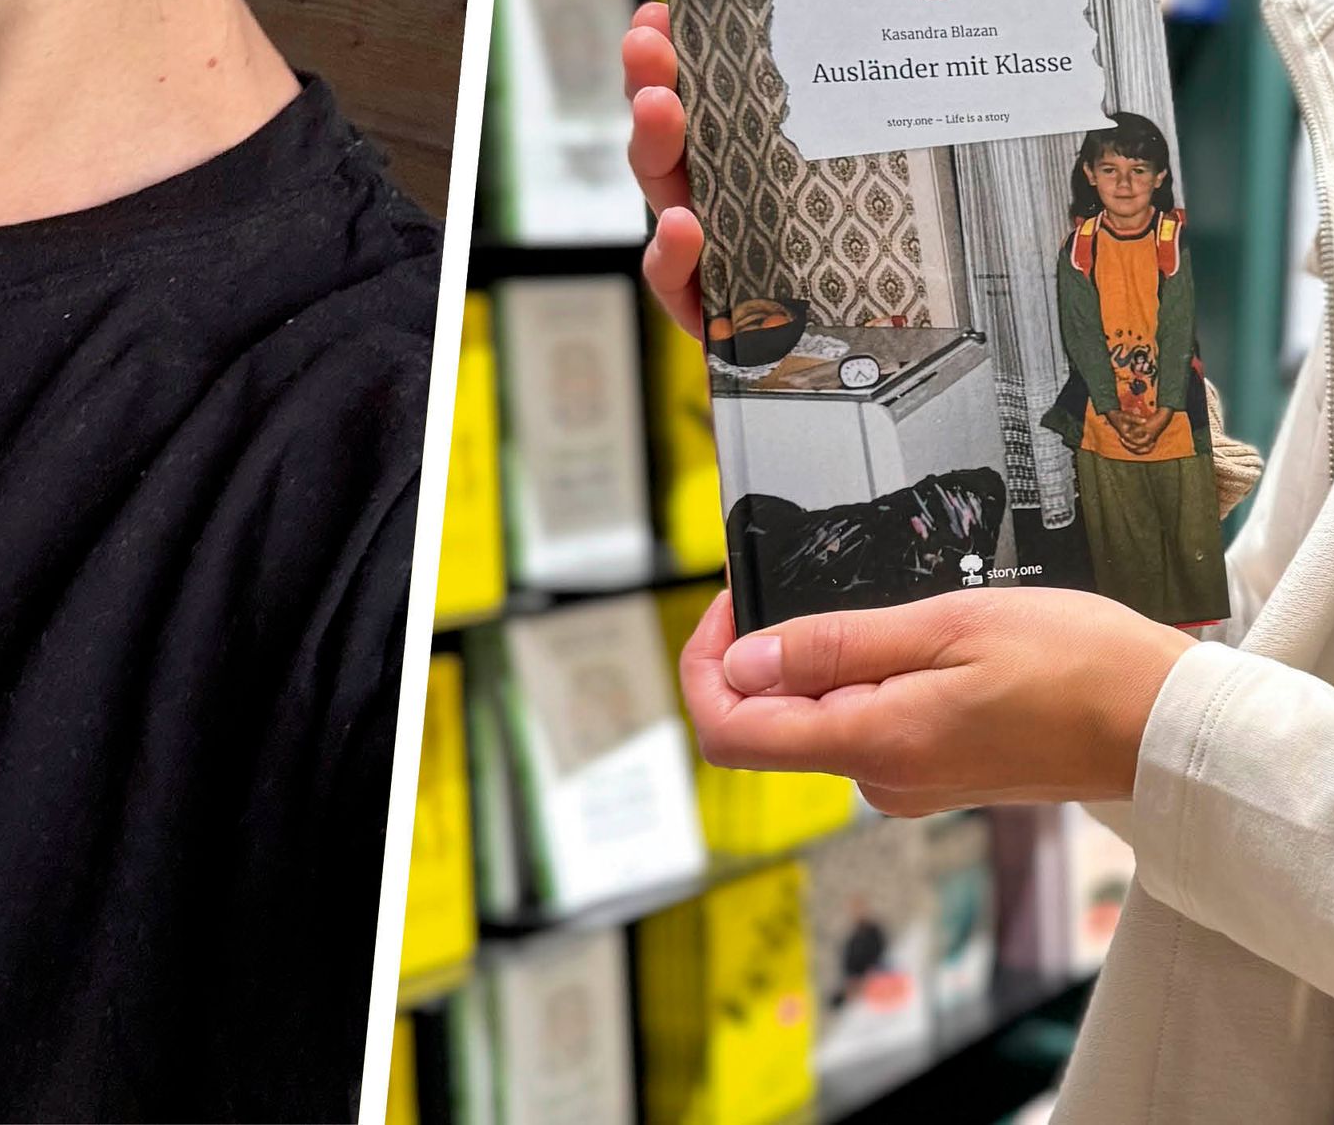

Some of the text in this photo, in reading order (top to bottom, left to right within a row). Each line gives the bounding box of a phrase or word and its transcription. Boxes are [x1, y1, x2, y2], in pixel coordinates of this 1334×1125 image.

[881, 25, 999, 41] Kasandra Blazan
[812, 53, 1073, 83] Ausländer mit Klasse
[887, 116, 933, 129] story.one
[945, 113, 965, 124] Life
[966, 113, 976, 124] is
[977, 114, 983, 123] a
[985, 111, 1011, 124] story
[987, 564, 1043, 580] story.one
